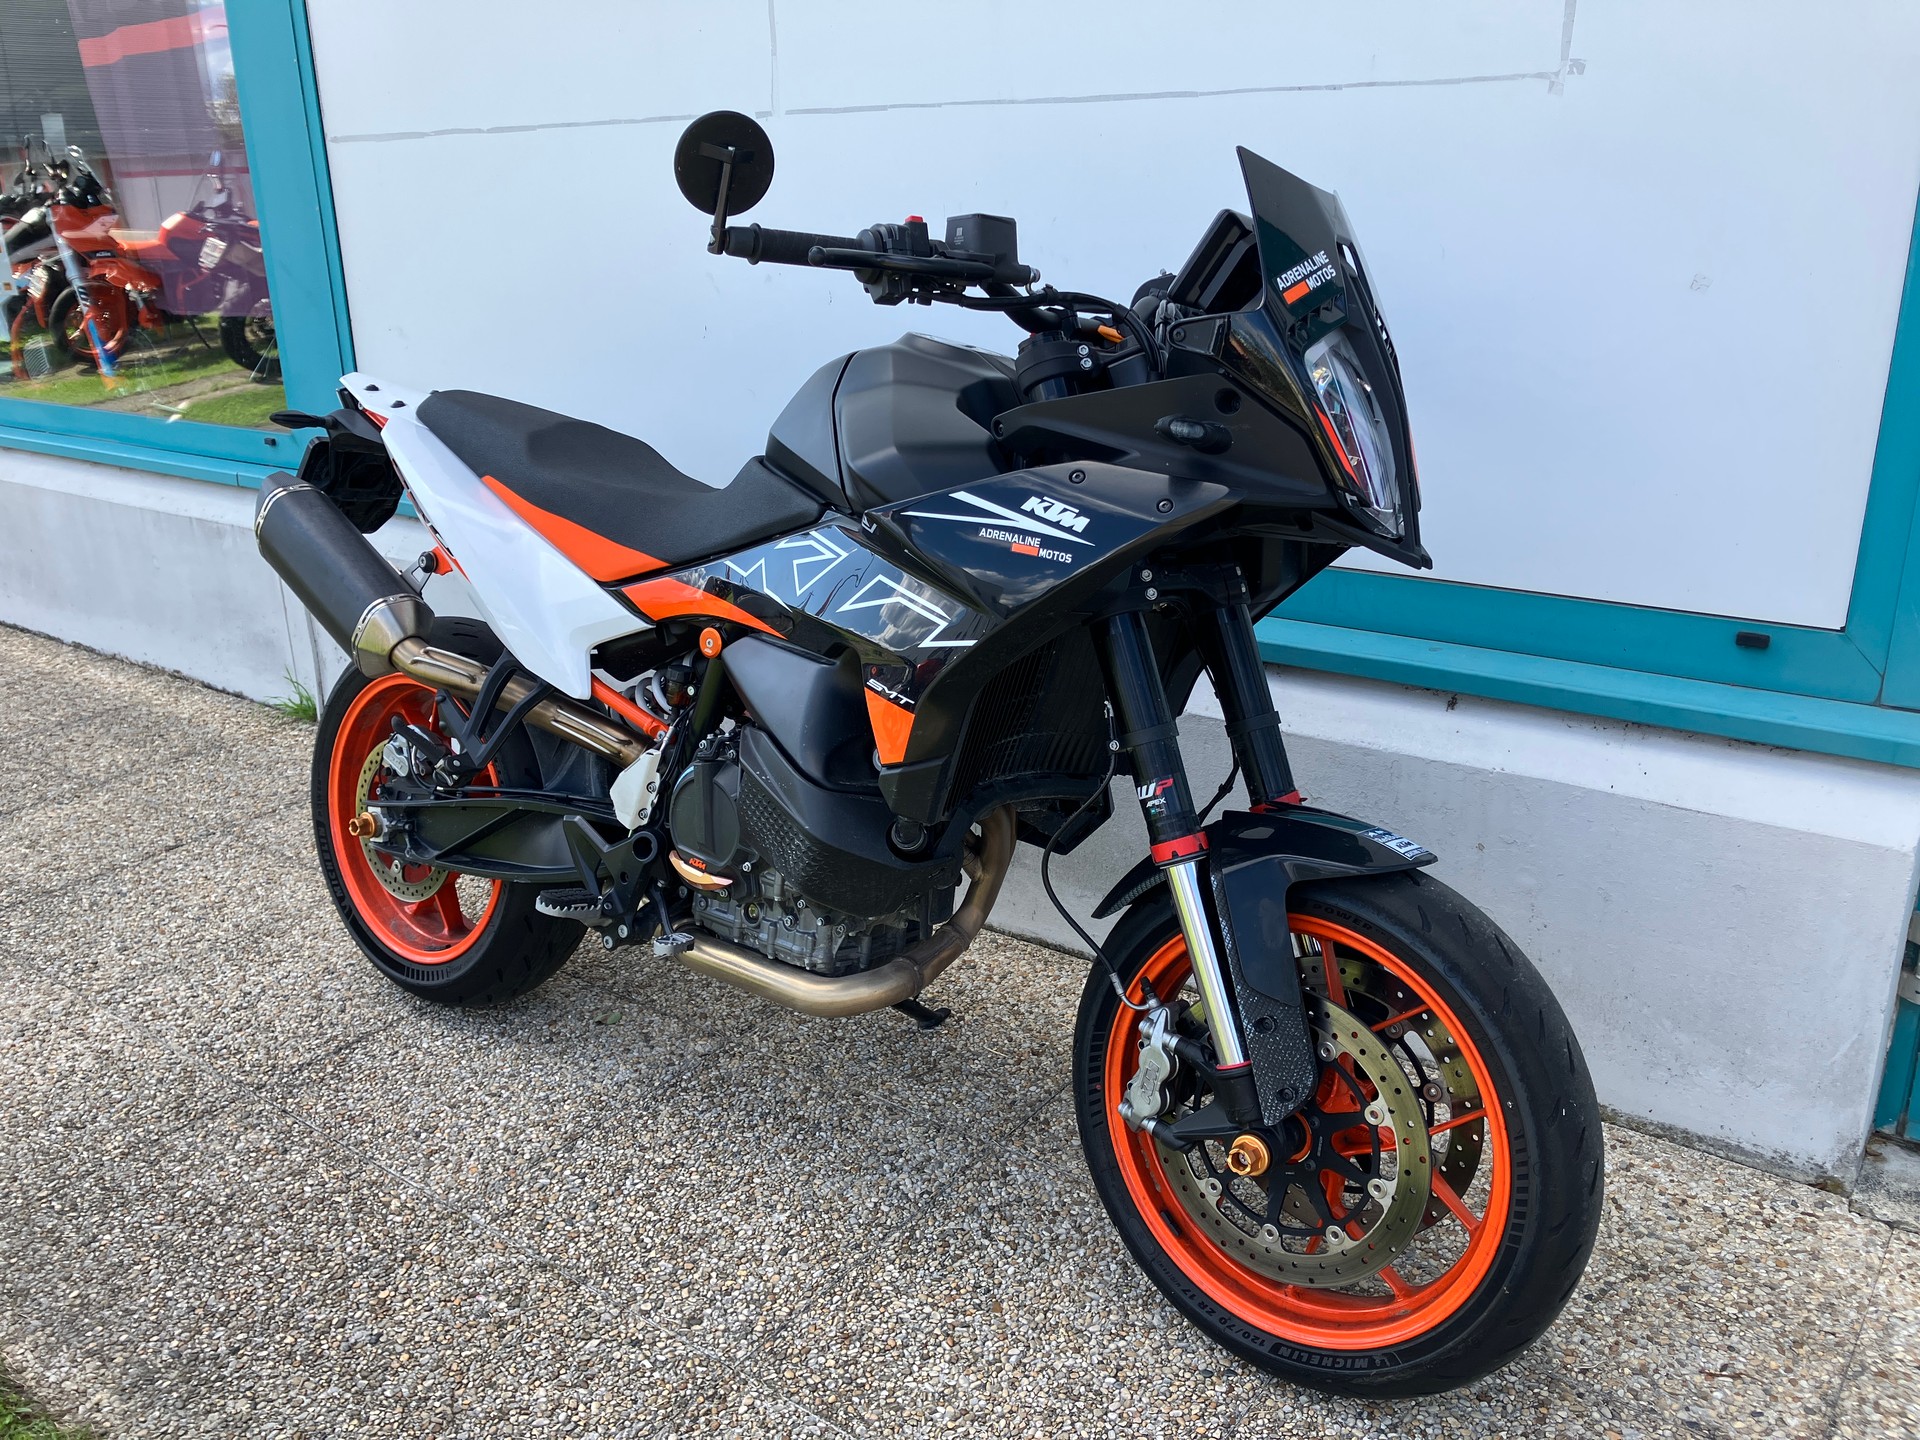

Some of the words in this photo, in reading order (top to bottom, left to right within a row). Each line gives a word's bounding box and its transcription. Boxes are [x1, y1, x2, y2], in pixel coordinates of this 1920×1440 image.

[1276, 250, 1330, 291] ADRENALINE
[1305, 264, 1337, 291] MOTOS
[1020, 495, 1091, 533] KTM
[978, 527, 1042, 547] ADRENALINE
[1038, 548, 1073, 564] MOTOS
[866, 678, 915, 705] SMT
[1137, 778, 1174, 800] WP
[318, 825, 344, 898] MICHELIN
[688, 857, 707, 870] KTM
[1312, 902, 1373, 931] POWER
[1180, 1287, 1197, 1302] 17
[1197, 1301, 1216, 1318] ZR
[1218, 1315, 1266, 1348] 120/70
[1278, 1346, 1368, 1370] MICHELIN
